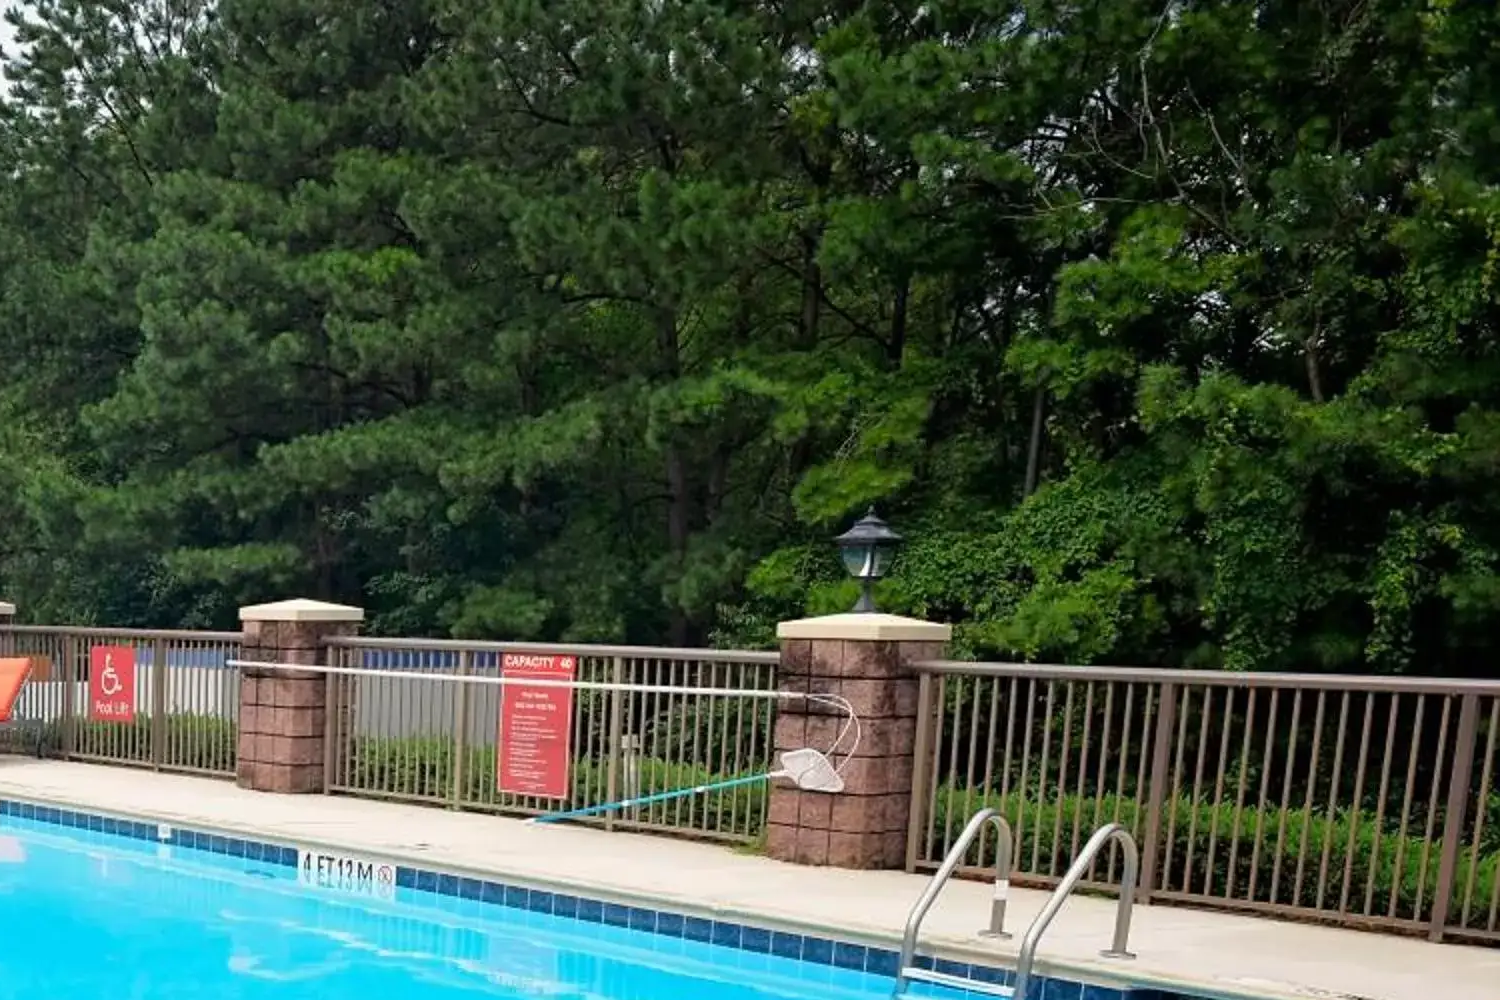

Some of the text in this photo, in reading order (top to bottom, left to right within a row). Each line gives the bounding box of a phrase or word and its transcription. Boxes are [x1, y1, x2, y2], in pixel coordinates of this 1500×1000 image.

[505, 654, 555, 668] CAPACITY
[95, 700, 129, 717] Pool Lift
[304, 852, 311, 871] 4
[317, 855, 335, 875] FT
[357, 862, 373, 880] M
